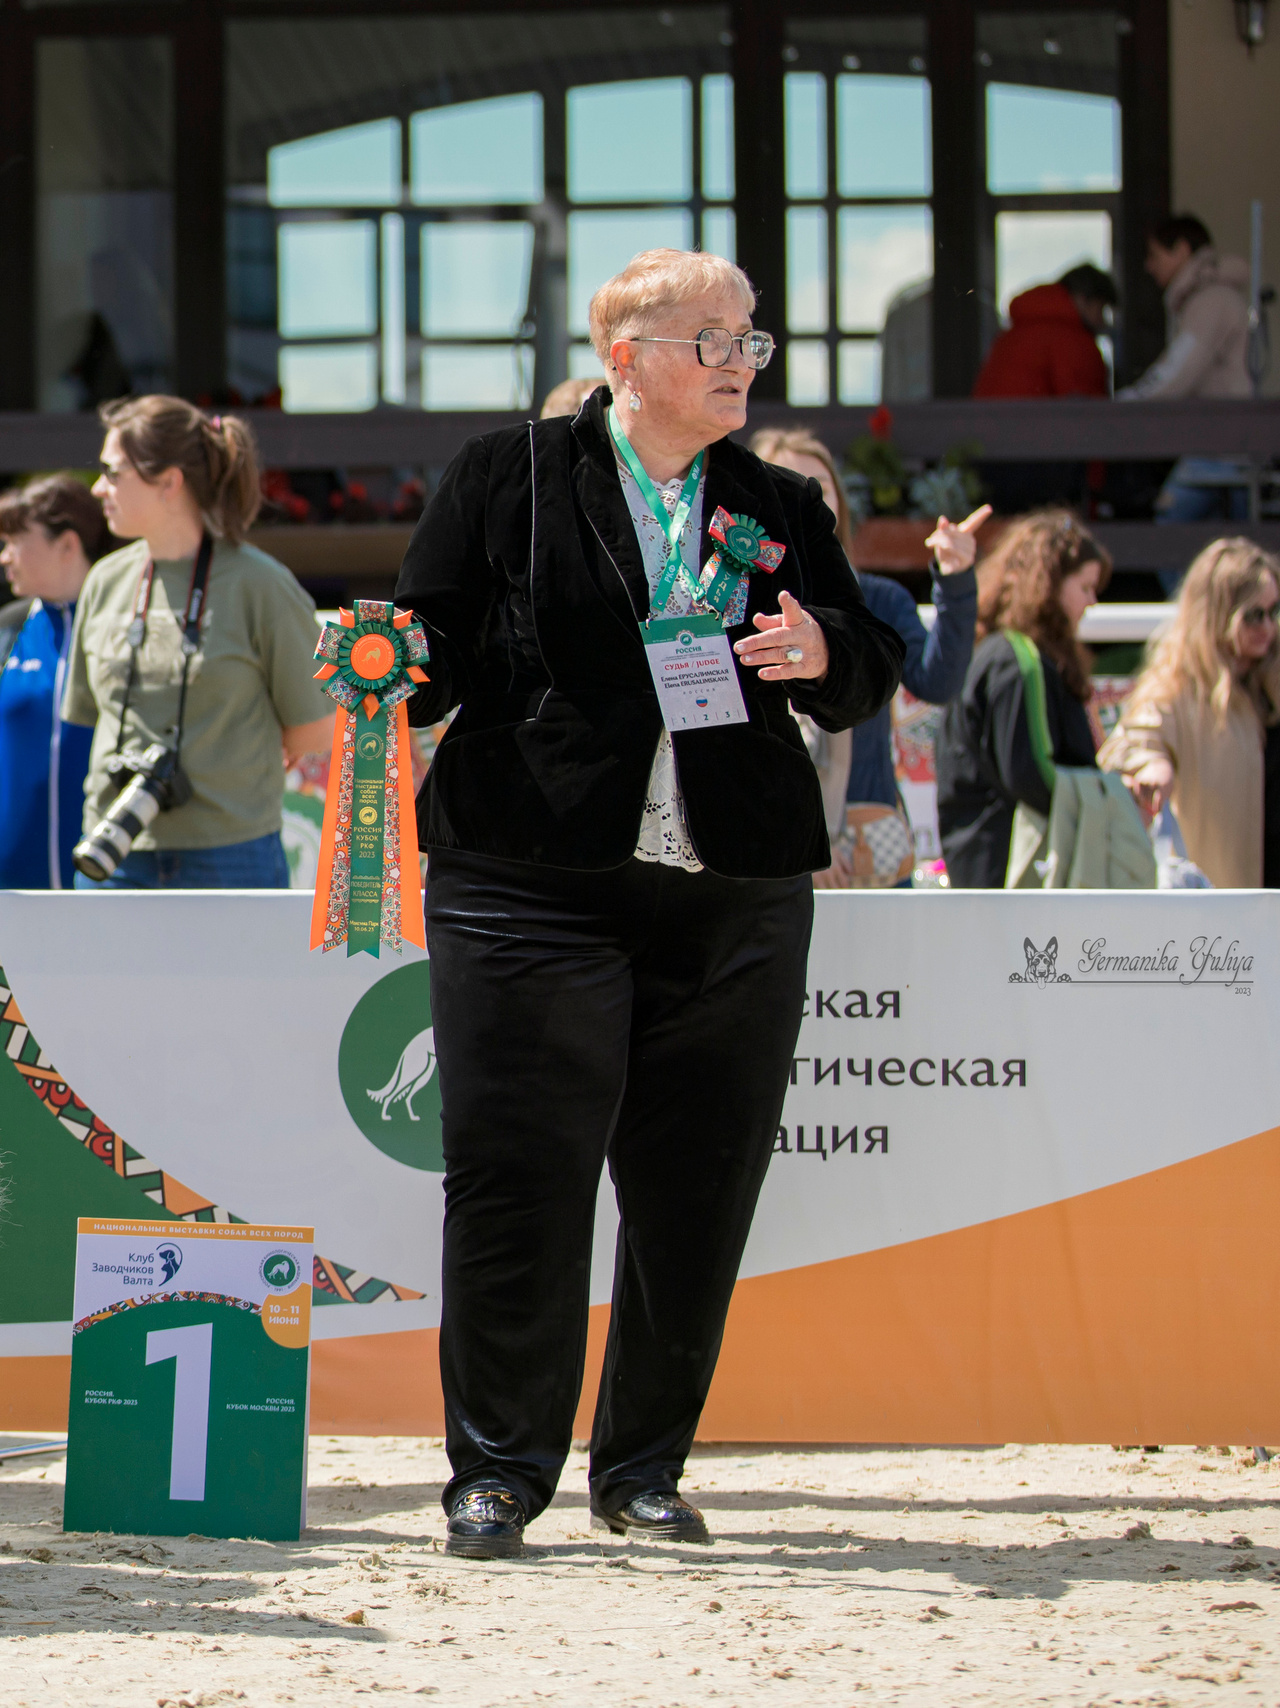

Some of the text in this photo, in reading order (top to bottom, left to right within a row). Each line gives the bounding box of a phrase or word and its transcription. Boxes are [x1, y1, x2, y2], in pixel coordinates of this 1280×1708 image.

[664, 564, 676, 583] РКФ
[675, 645, 702, 655] РОССИЯ
[664, 662, 689, 671] СУДЬЯ
[696, 658, 720, 668] JUDGE
[703, 713, 709, 721] 2
[773, 1125, 889, 1161] ация
[93, 1223, 167, 1233] НАЦИОНАЛЬНЫЕ
[169, 1226, 216, 1235] ВЫСТАВКИ
[218, 1228, 247, 1236] СОБАК
[274, 1231, 304, 1239] ПОРОД
[128, 1252, 155, 1264] Клуб
[91, 1262, 154, 1275] Заводчиков
[123, 1275, 154, 1286] Валта
[269, 1305, 280, 1314] 10
[290, 1305, 300, 1314] 11
[268, 1316, 300, 1325] ИЮНЯ
[145, 1322, 213, 1502] 1
[226, 1403, 249, 1411] КУБОК
[249, 1404, 280, 1412] МОСКВЫ
